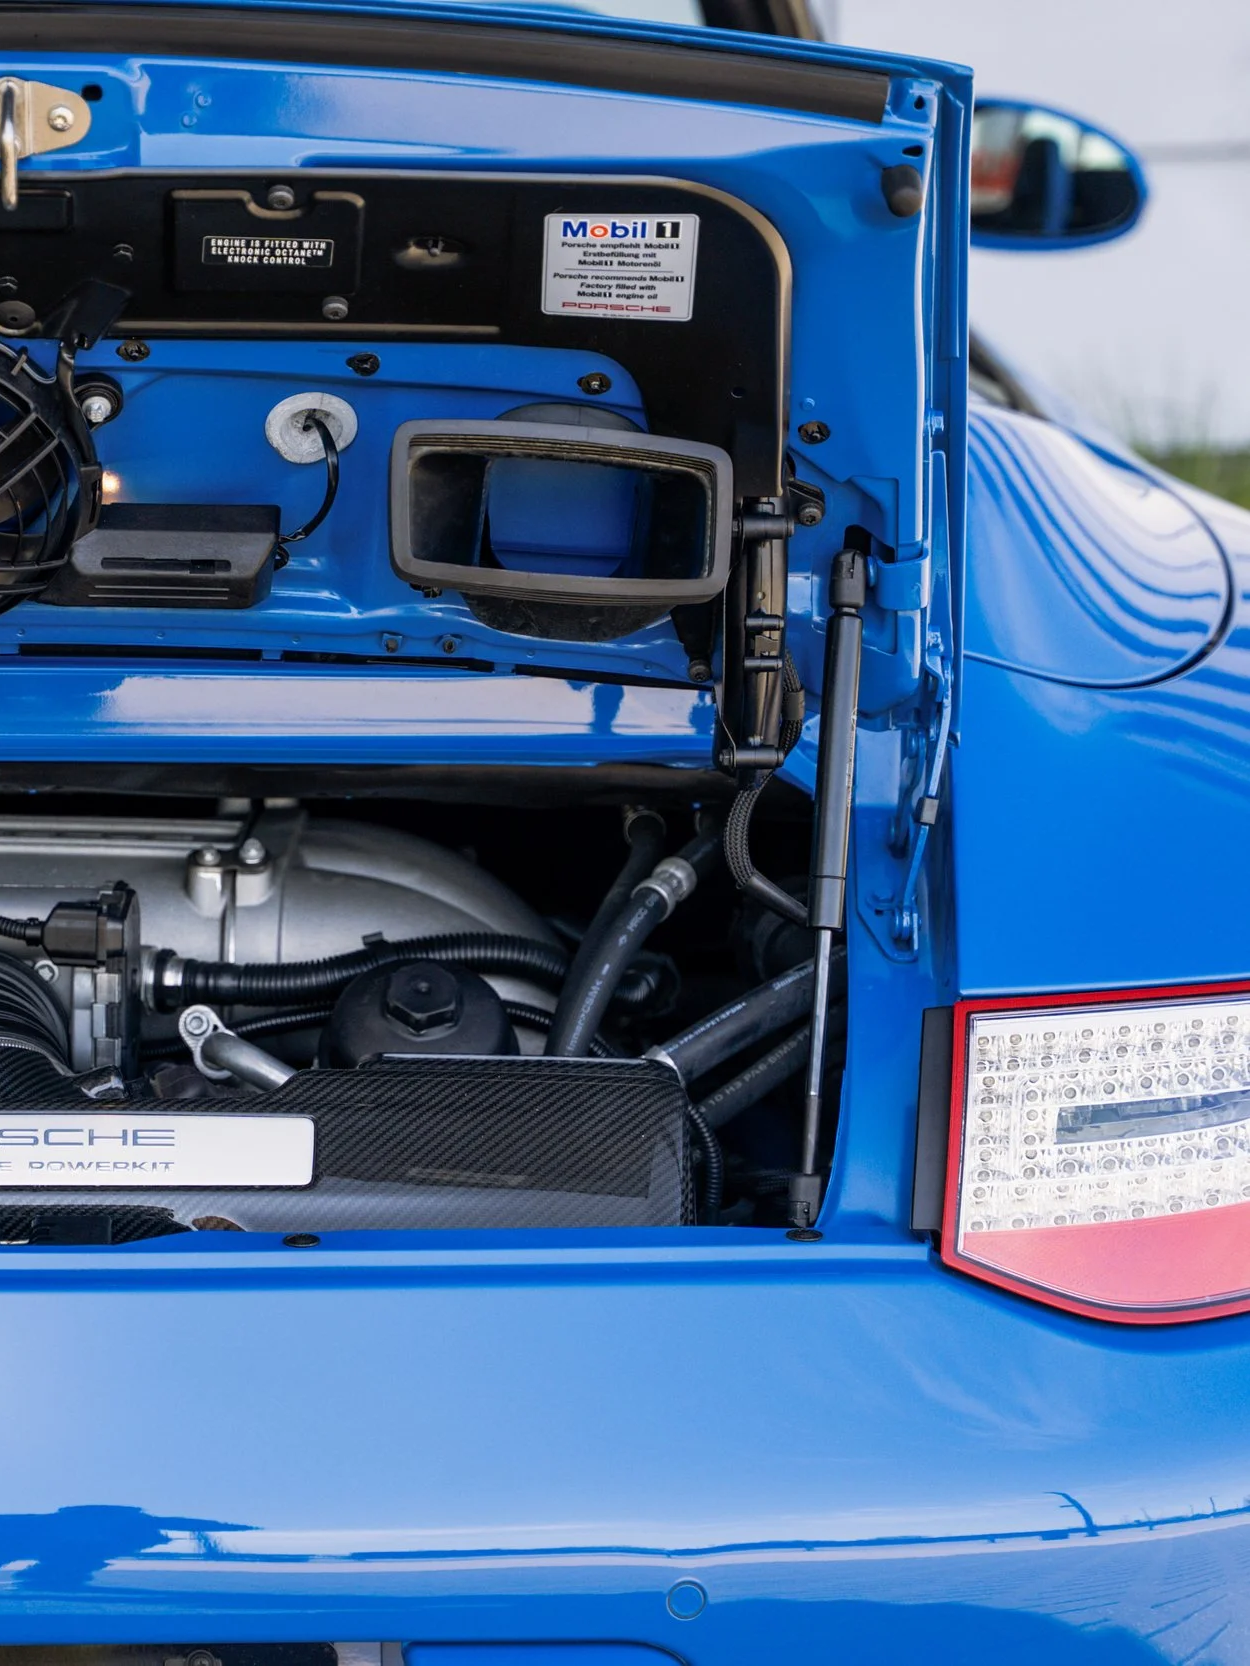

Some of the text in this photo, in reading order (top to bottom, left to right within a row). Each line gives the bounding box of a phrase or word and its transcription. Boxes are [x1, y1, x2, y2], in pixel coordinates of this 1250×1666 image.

[562, 221, 647, 238] Mobil
[211, 238, 246, 247] ENGINE
[264, 240, 298, 248] FITTED
[303, 241, 326, 249] WITH
[211, 247, 270, 256] ELECTRONIC
[583, 251, 640, 259] Erstbefüllung
[227, 255, 306, 265] KNOCK CONTROL
[553, 272, 588, 280] Porsche
[580, 282, 613, 290] Factory
[562, 302, 671, 312] PORSCHE
[28, 1161, 175, 1172] POWERKIT
